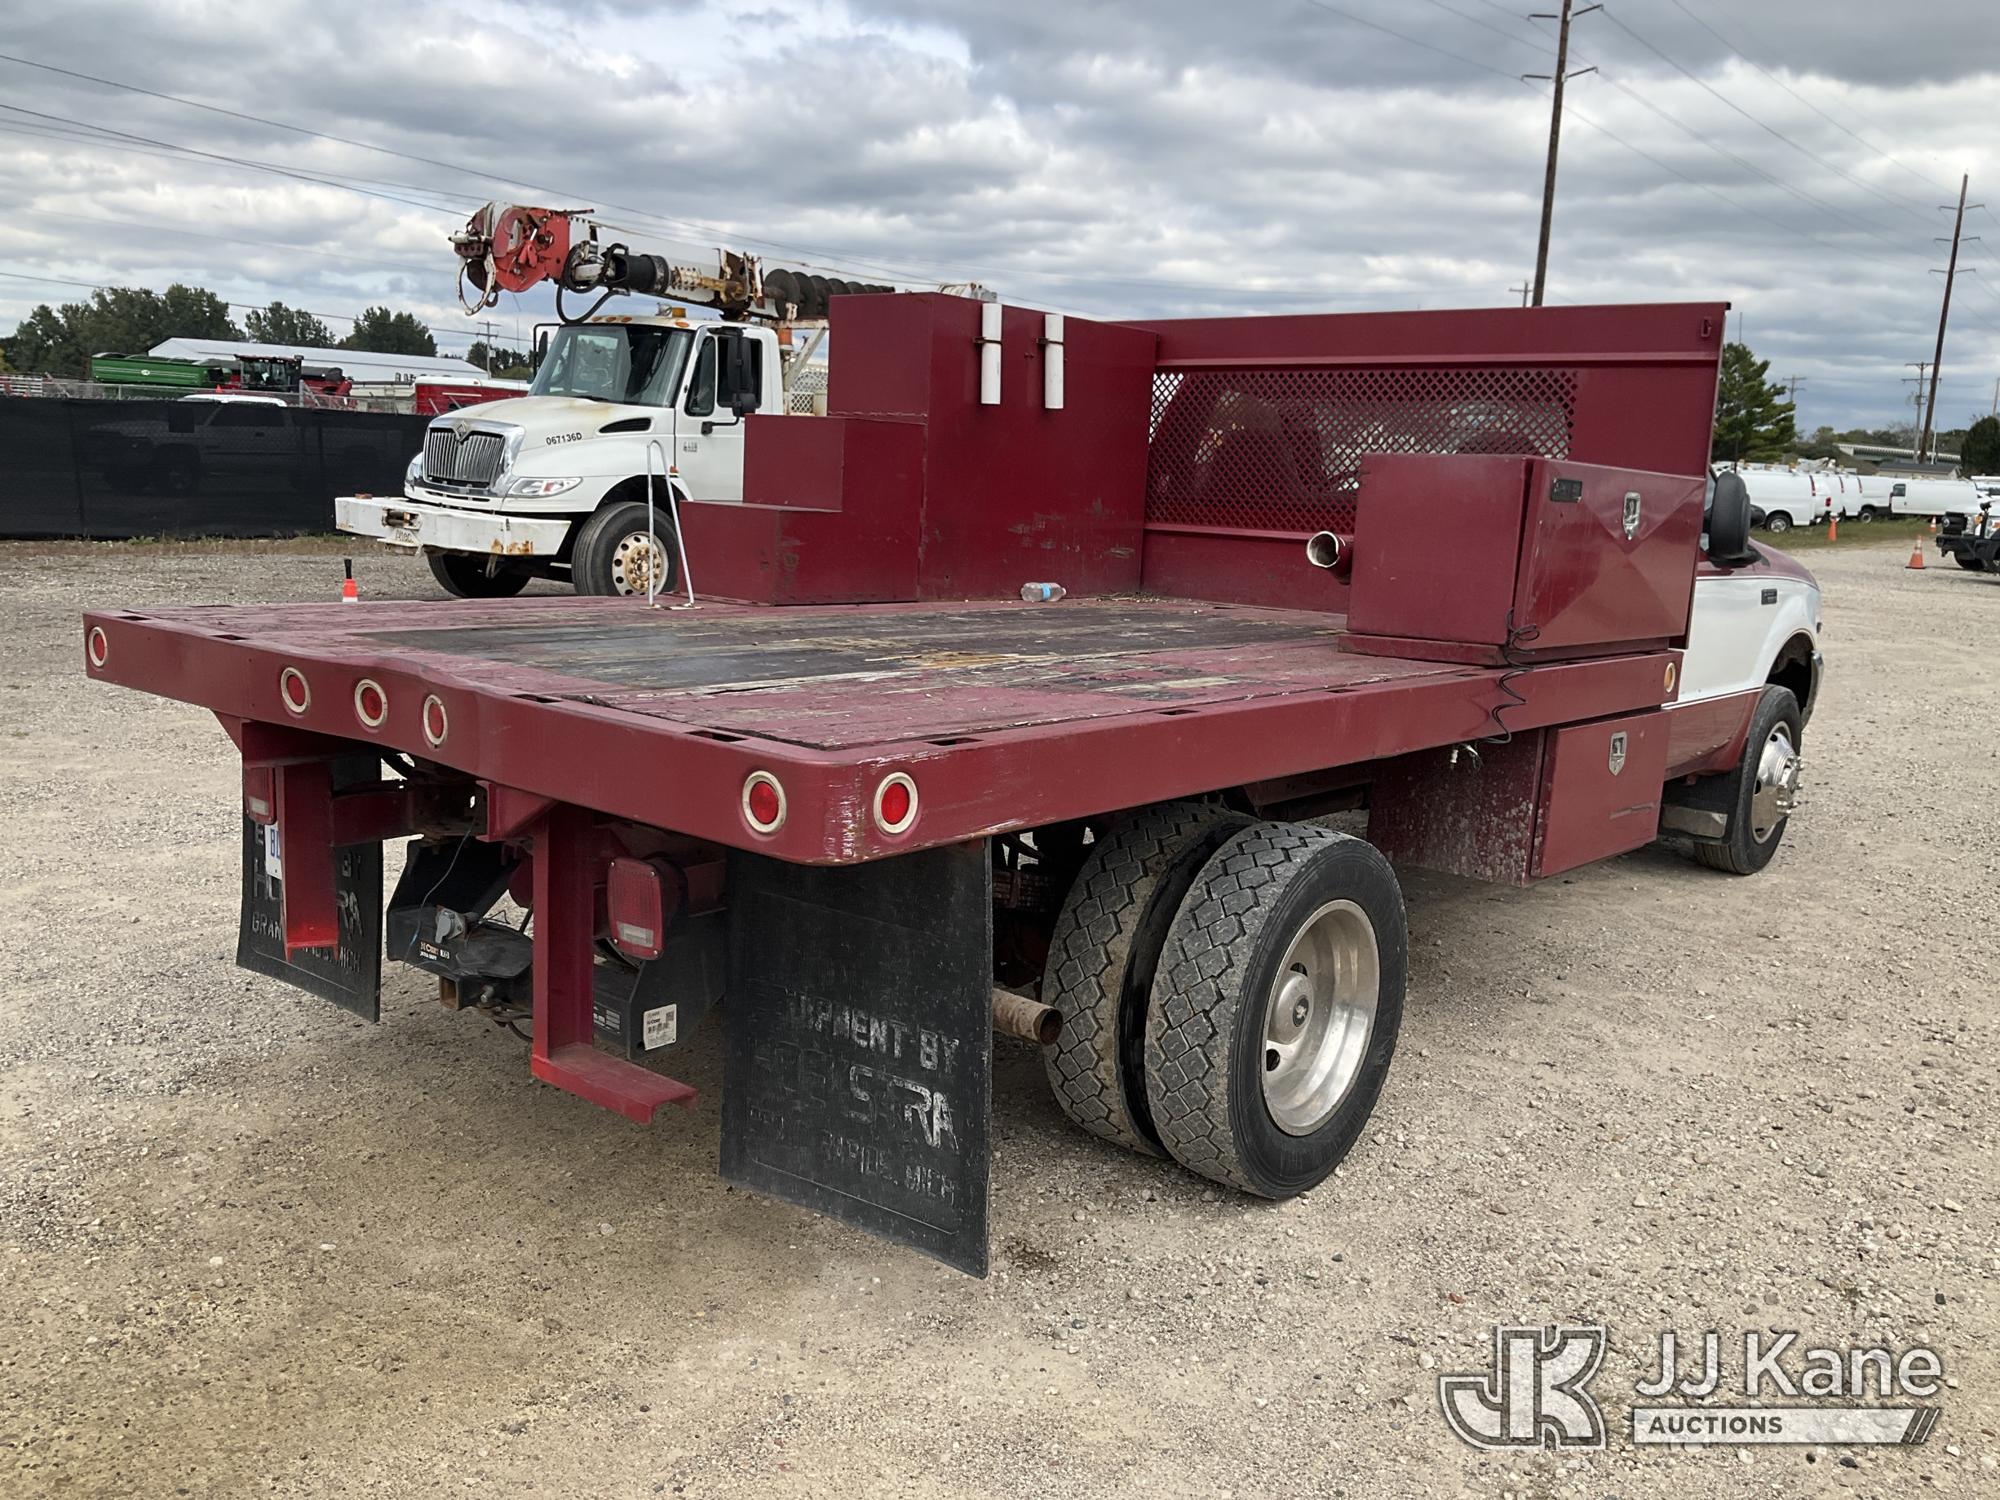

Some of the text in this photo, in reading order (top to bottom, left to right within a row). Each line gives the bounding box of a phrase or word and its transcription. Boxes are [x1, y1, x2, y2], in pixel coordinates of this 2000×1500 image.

[545, 432, 583, 446] 067136D
[252, 911, 282, 942] GRAN
[919, 1028, 960, 1073] BY
